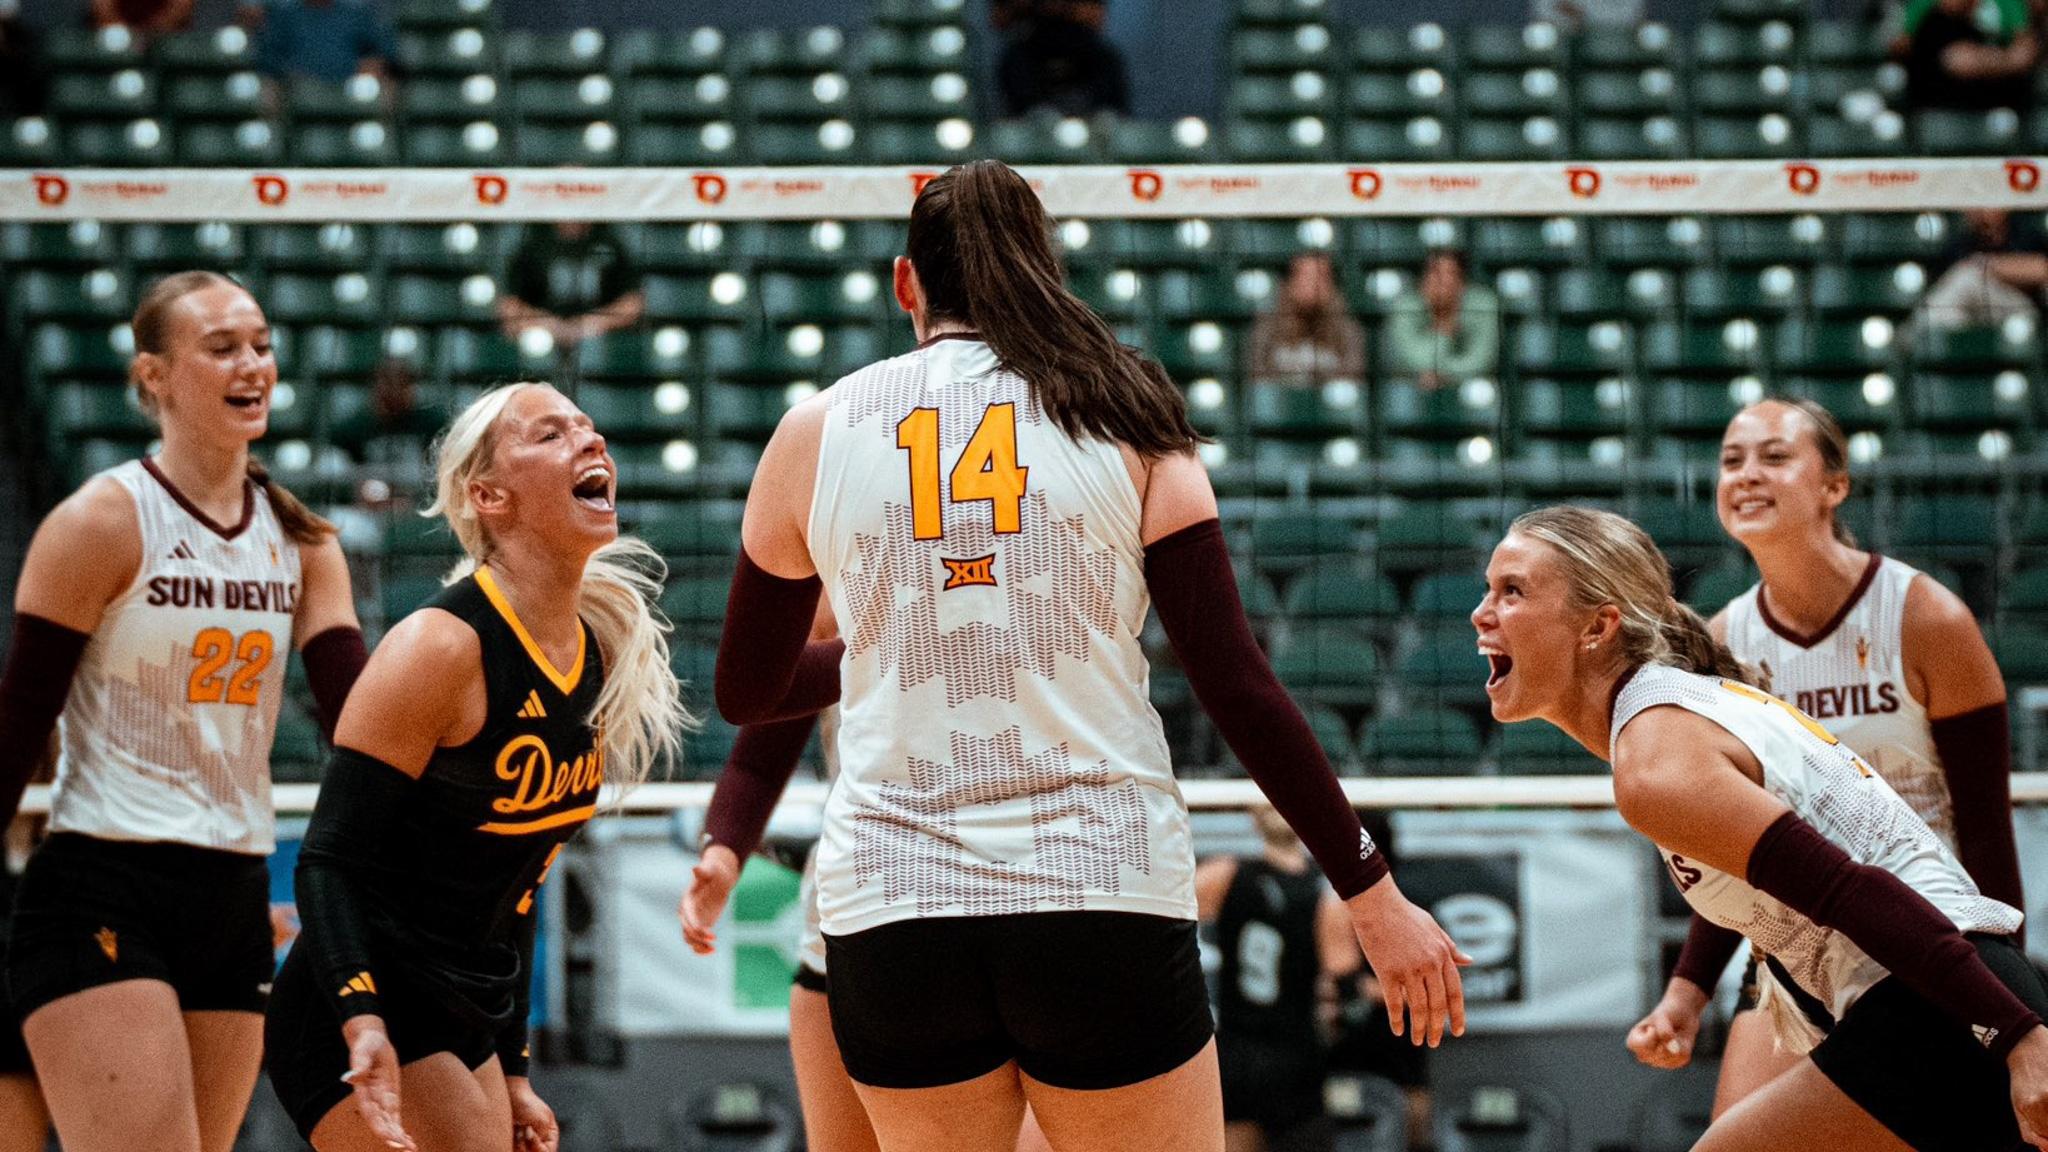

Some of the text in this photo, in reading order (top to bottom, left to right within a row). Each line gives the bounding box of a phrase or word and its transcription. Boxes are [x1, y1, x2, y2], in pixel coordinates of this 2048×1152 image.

[897, 402, 1029, 541] 14
[941, 553, 998, 591] XII
[147, 575, 214, 608] SUN
[187, 626, 275, 706] 22
[1796, 682, 1900, 719] DEVILS
